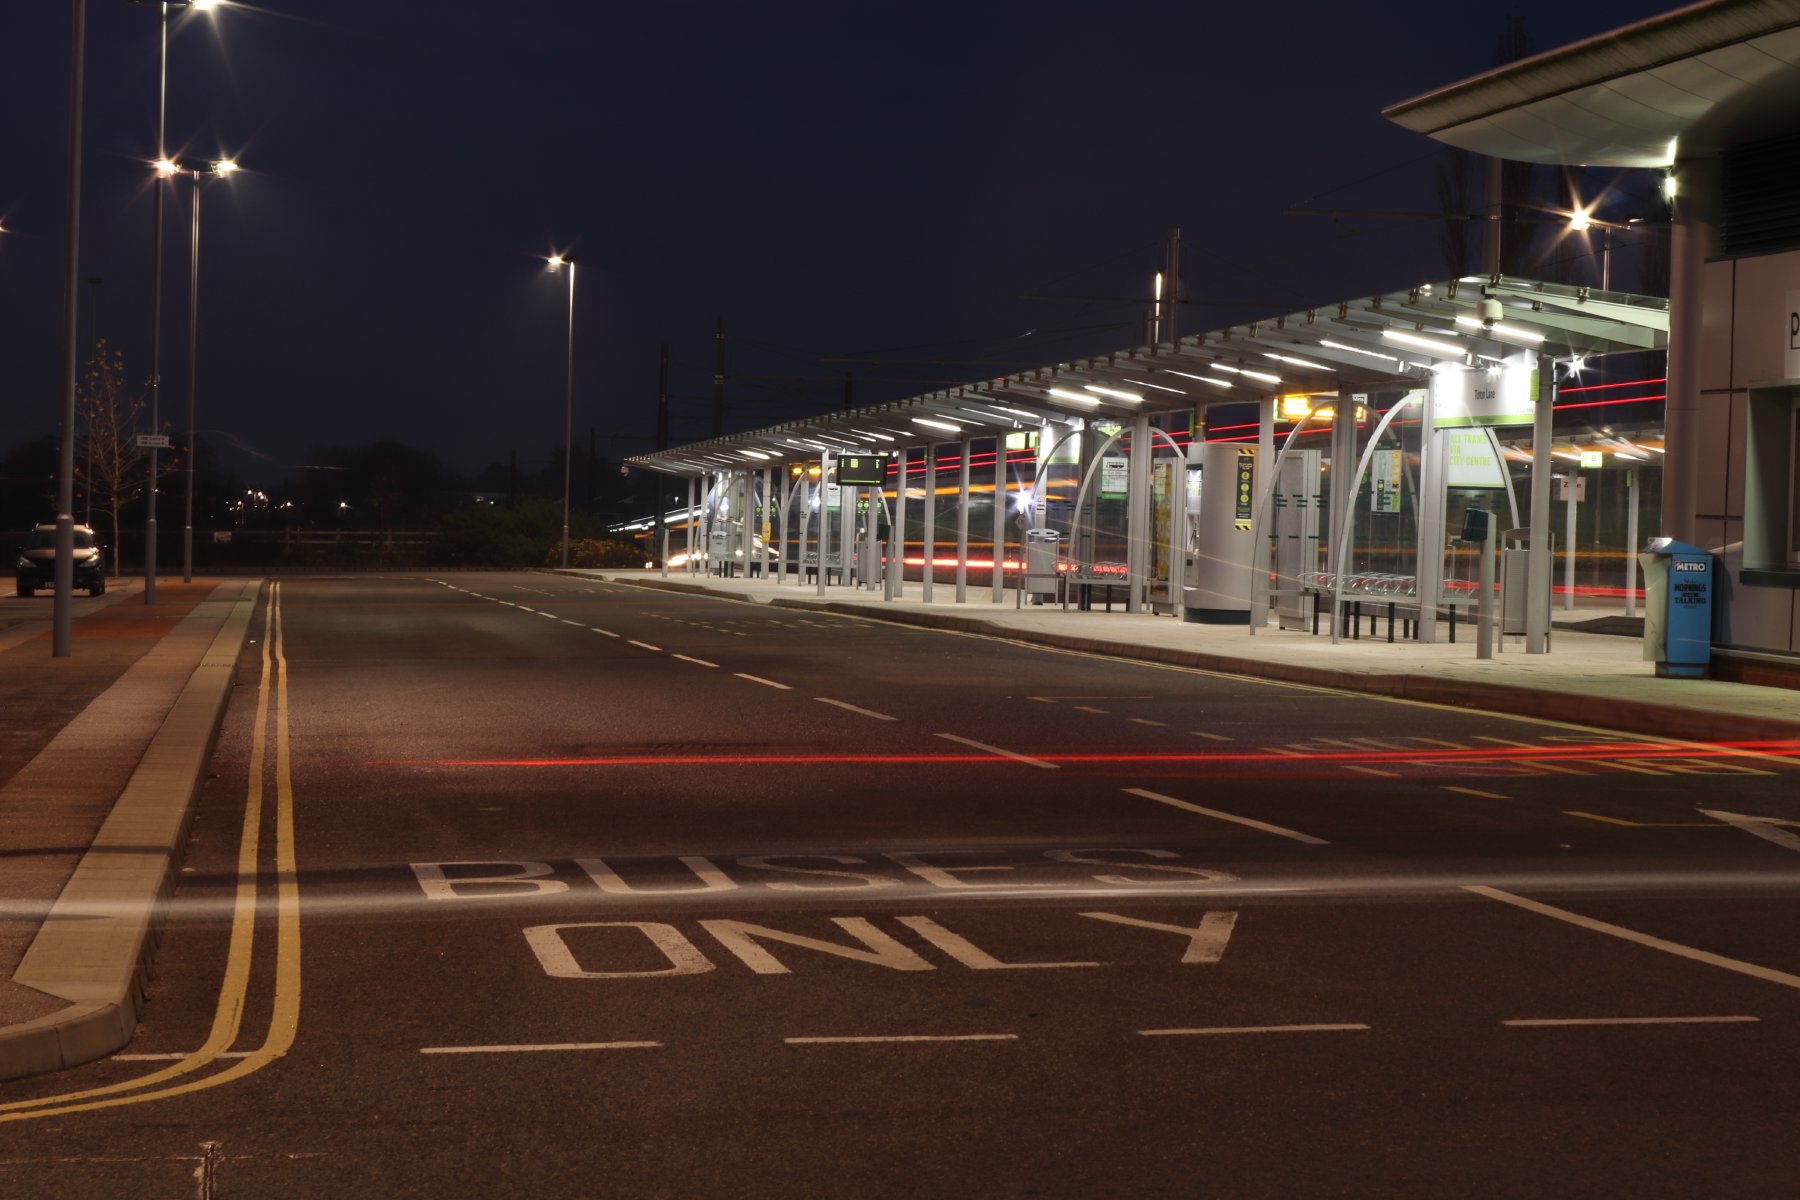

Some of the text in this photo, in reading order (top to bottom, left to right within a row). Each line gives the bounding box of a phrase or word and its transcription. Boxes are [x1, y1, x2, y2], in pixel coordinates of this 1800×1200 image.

[1486, 388, 1495, 399] Lane
[1449, 455, 1491, 465] CITY CENTRE
[1676, 562, 1706, 571] METRO
[1674, 584, 1706, 592] MORNINGS
[409, 848, 1240, 901] BUSES
[523, 910, 1239, 978] ONLY
